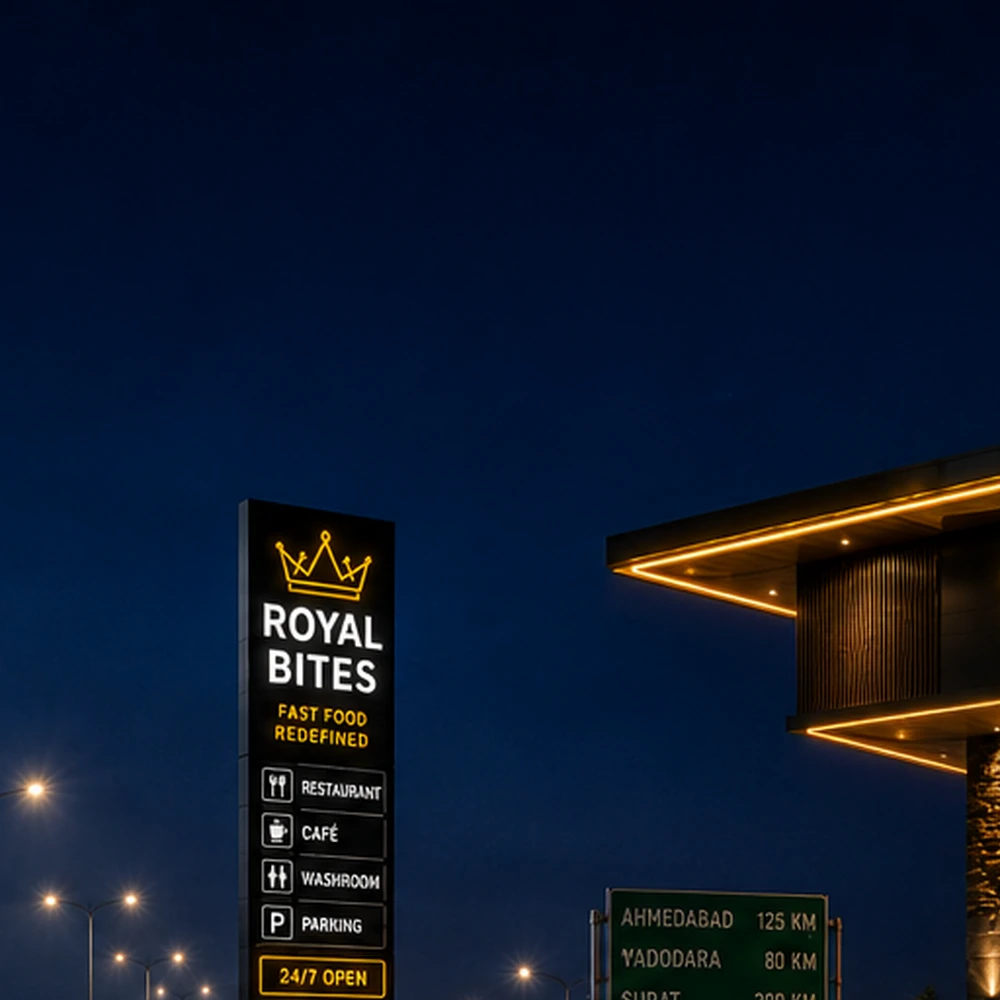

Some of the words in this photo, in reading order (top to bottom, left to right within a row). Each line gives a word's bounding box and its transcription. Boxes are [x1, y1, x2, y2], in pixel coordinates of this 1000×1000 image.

[264, 602, 383, 651] ROYAL
[268, 648, 377, 694] BITES
[277, 703, 319, 722] FAST
[323, 708, 368, 728] FOOD
[275, 724, 369, 748] REDEFINED
[301, 779, 382, 802] RESTAURANT
[301, 823, 339, 843] CAFÉ
[301, 871, 380, 890] WASHROOM
[270, 911, 285, 934] P
[301, 916, 363, 934] PARKING
[620, 907, 734, 929] AHMEDABAD
[757, 911, 786, 931] 125
[791, 912, 817, 931] KM
[764, 950, 785, 970] 80
[791, 952, 817, 971] KM
[279, 967, 318, 985] 24/7
[322, 968, 367, 987] OPEN
